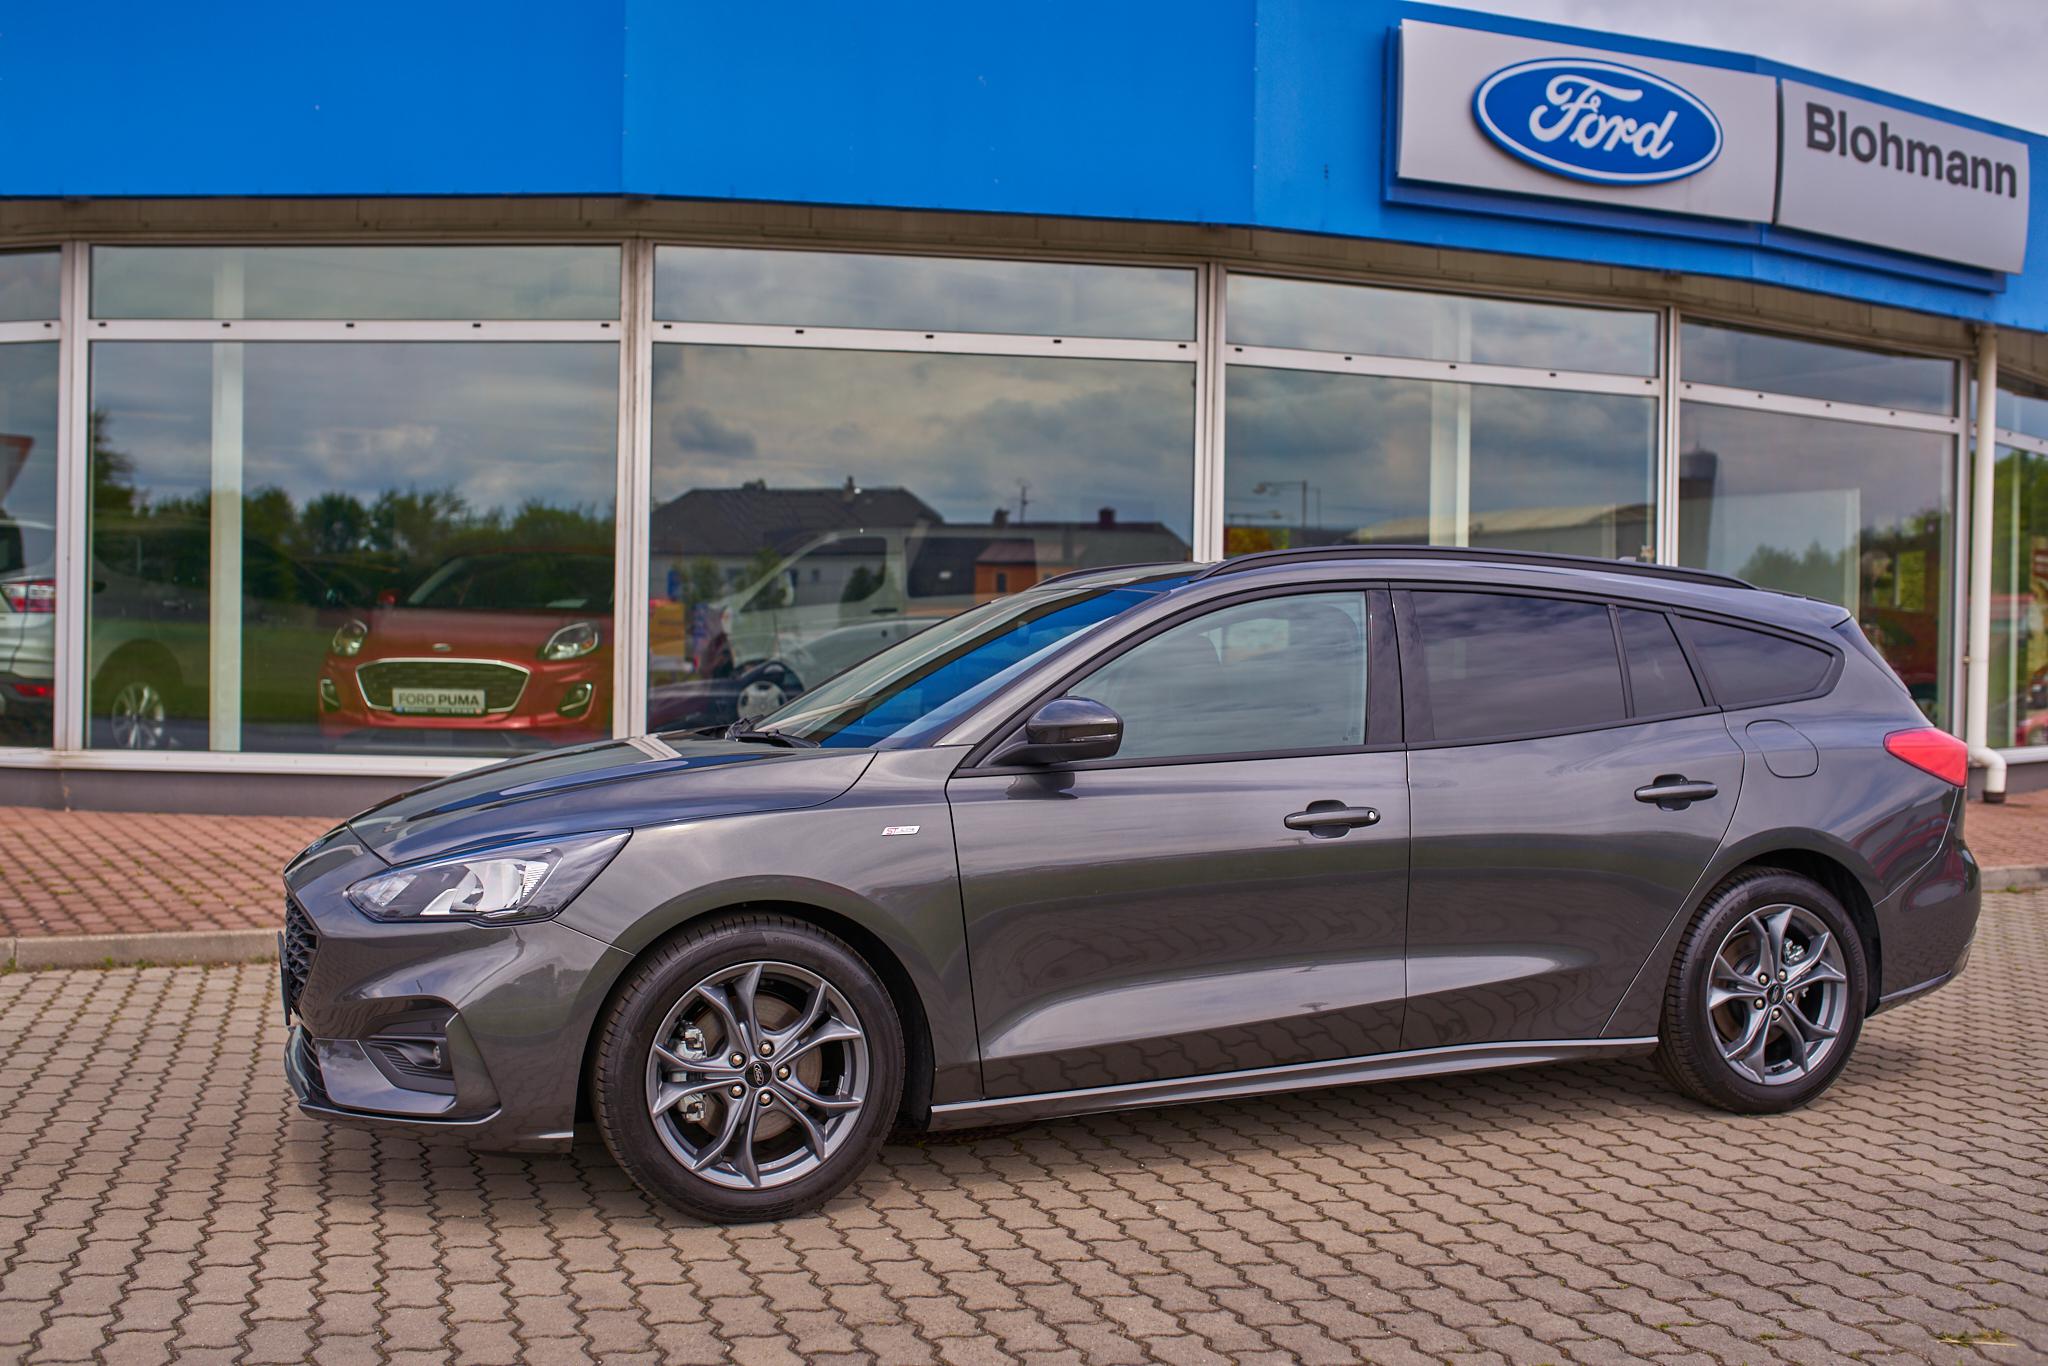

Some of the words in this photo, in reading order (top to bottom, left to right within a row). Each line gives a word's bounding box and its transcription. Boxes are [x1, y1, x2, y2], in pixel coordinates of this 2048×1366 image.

[1528, 73, 1679, 161] Ford
[1805, 101, 2018, 199] Blohmann
[398, 692, 435, 705] FORD
[437, 694, 480, 706] PUMA
